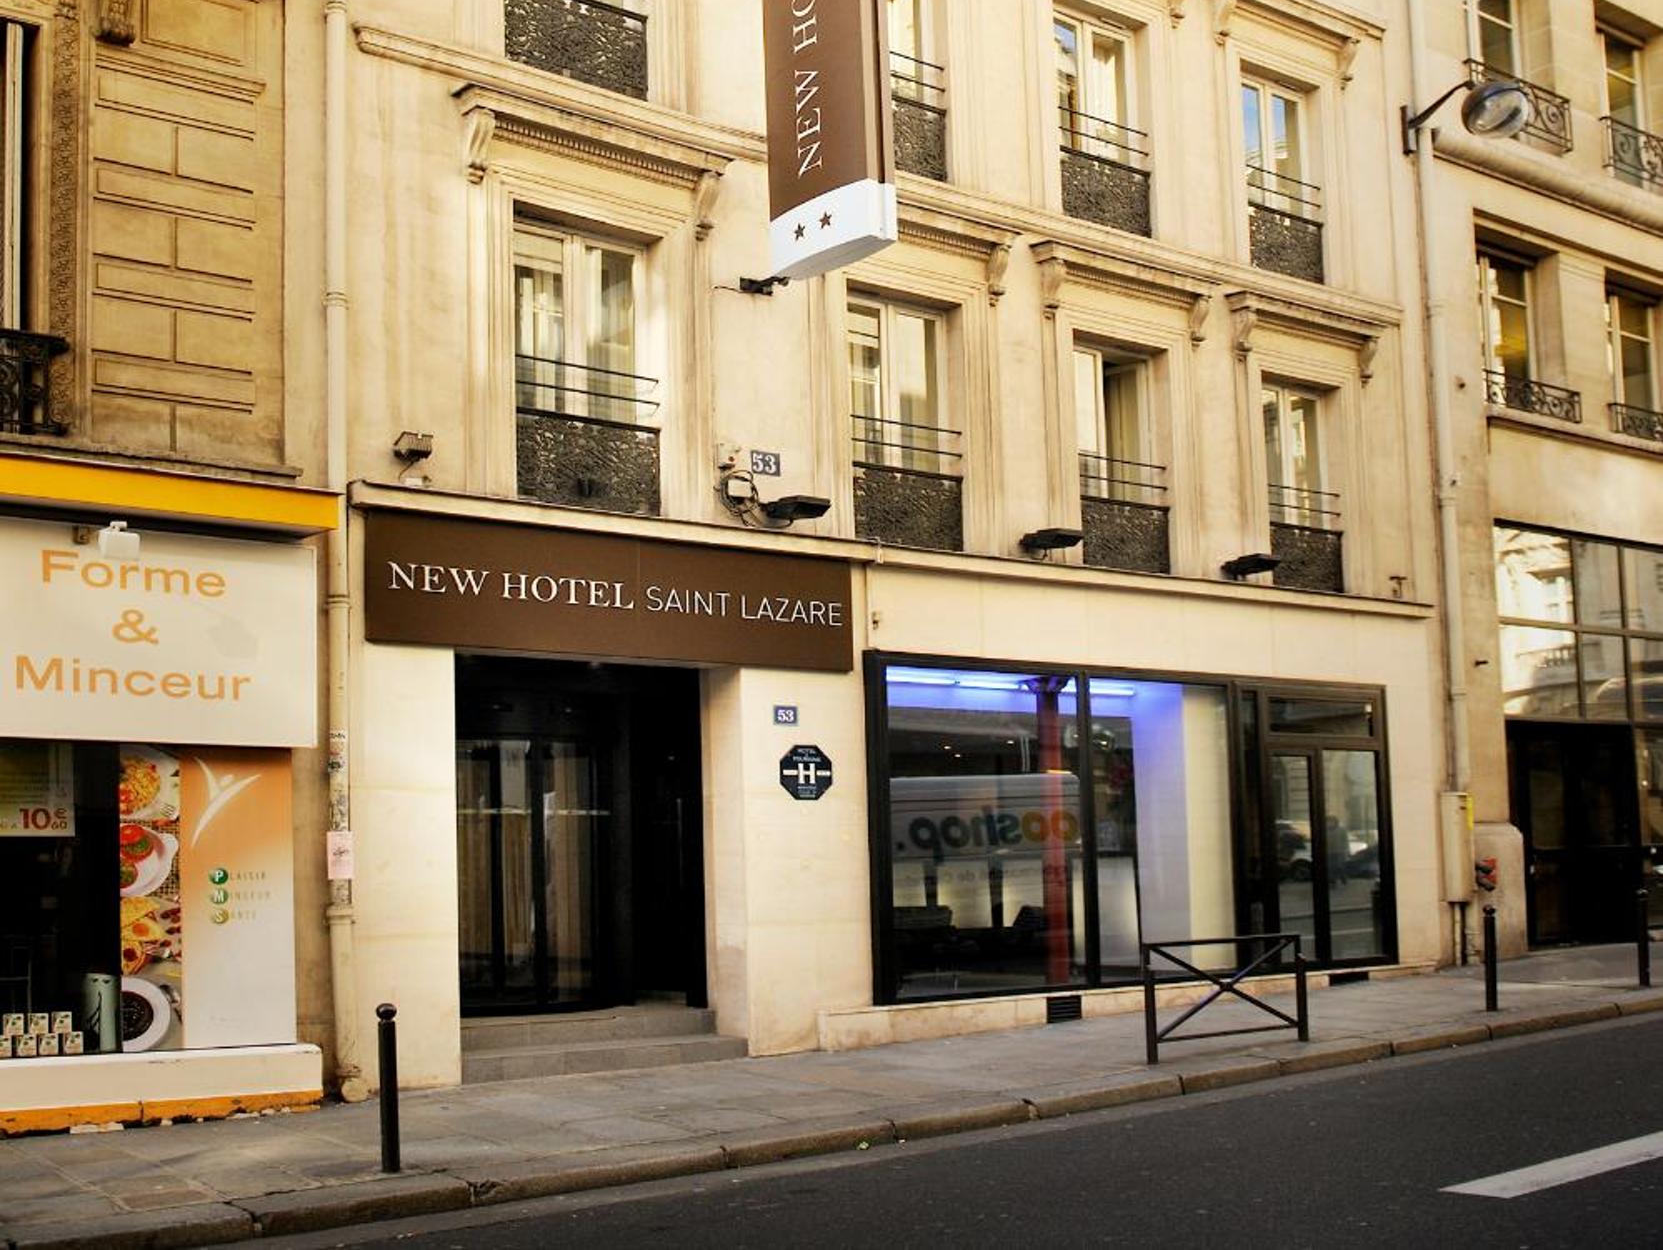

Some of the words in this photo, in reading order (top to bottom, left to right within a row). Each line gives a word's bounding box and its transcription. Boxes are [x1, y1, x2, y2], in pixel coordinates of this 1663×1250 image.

[795, 70, 822, 178] NEW
[752, 453, 777, 474] 53
[41, 550, 226, 597] Forme
[388, 561, 489, 596] NEW
[502, 572, 634, 610] HOTEL
[646, 586, 730, 617] SAINT
[741, 594, 843, 627] LAZARE
[112, 609, 159, 645] &
[15, 655, 251, 701] Minceur
[777, 709, 795, 723] 53
[798, 762, 816, 784] H
